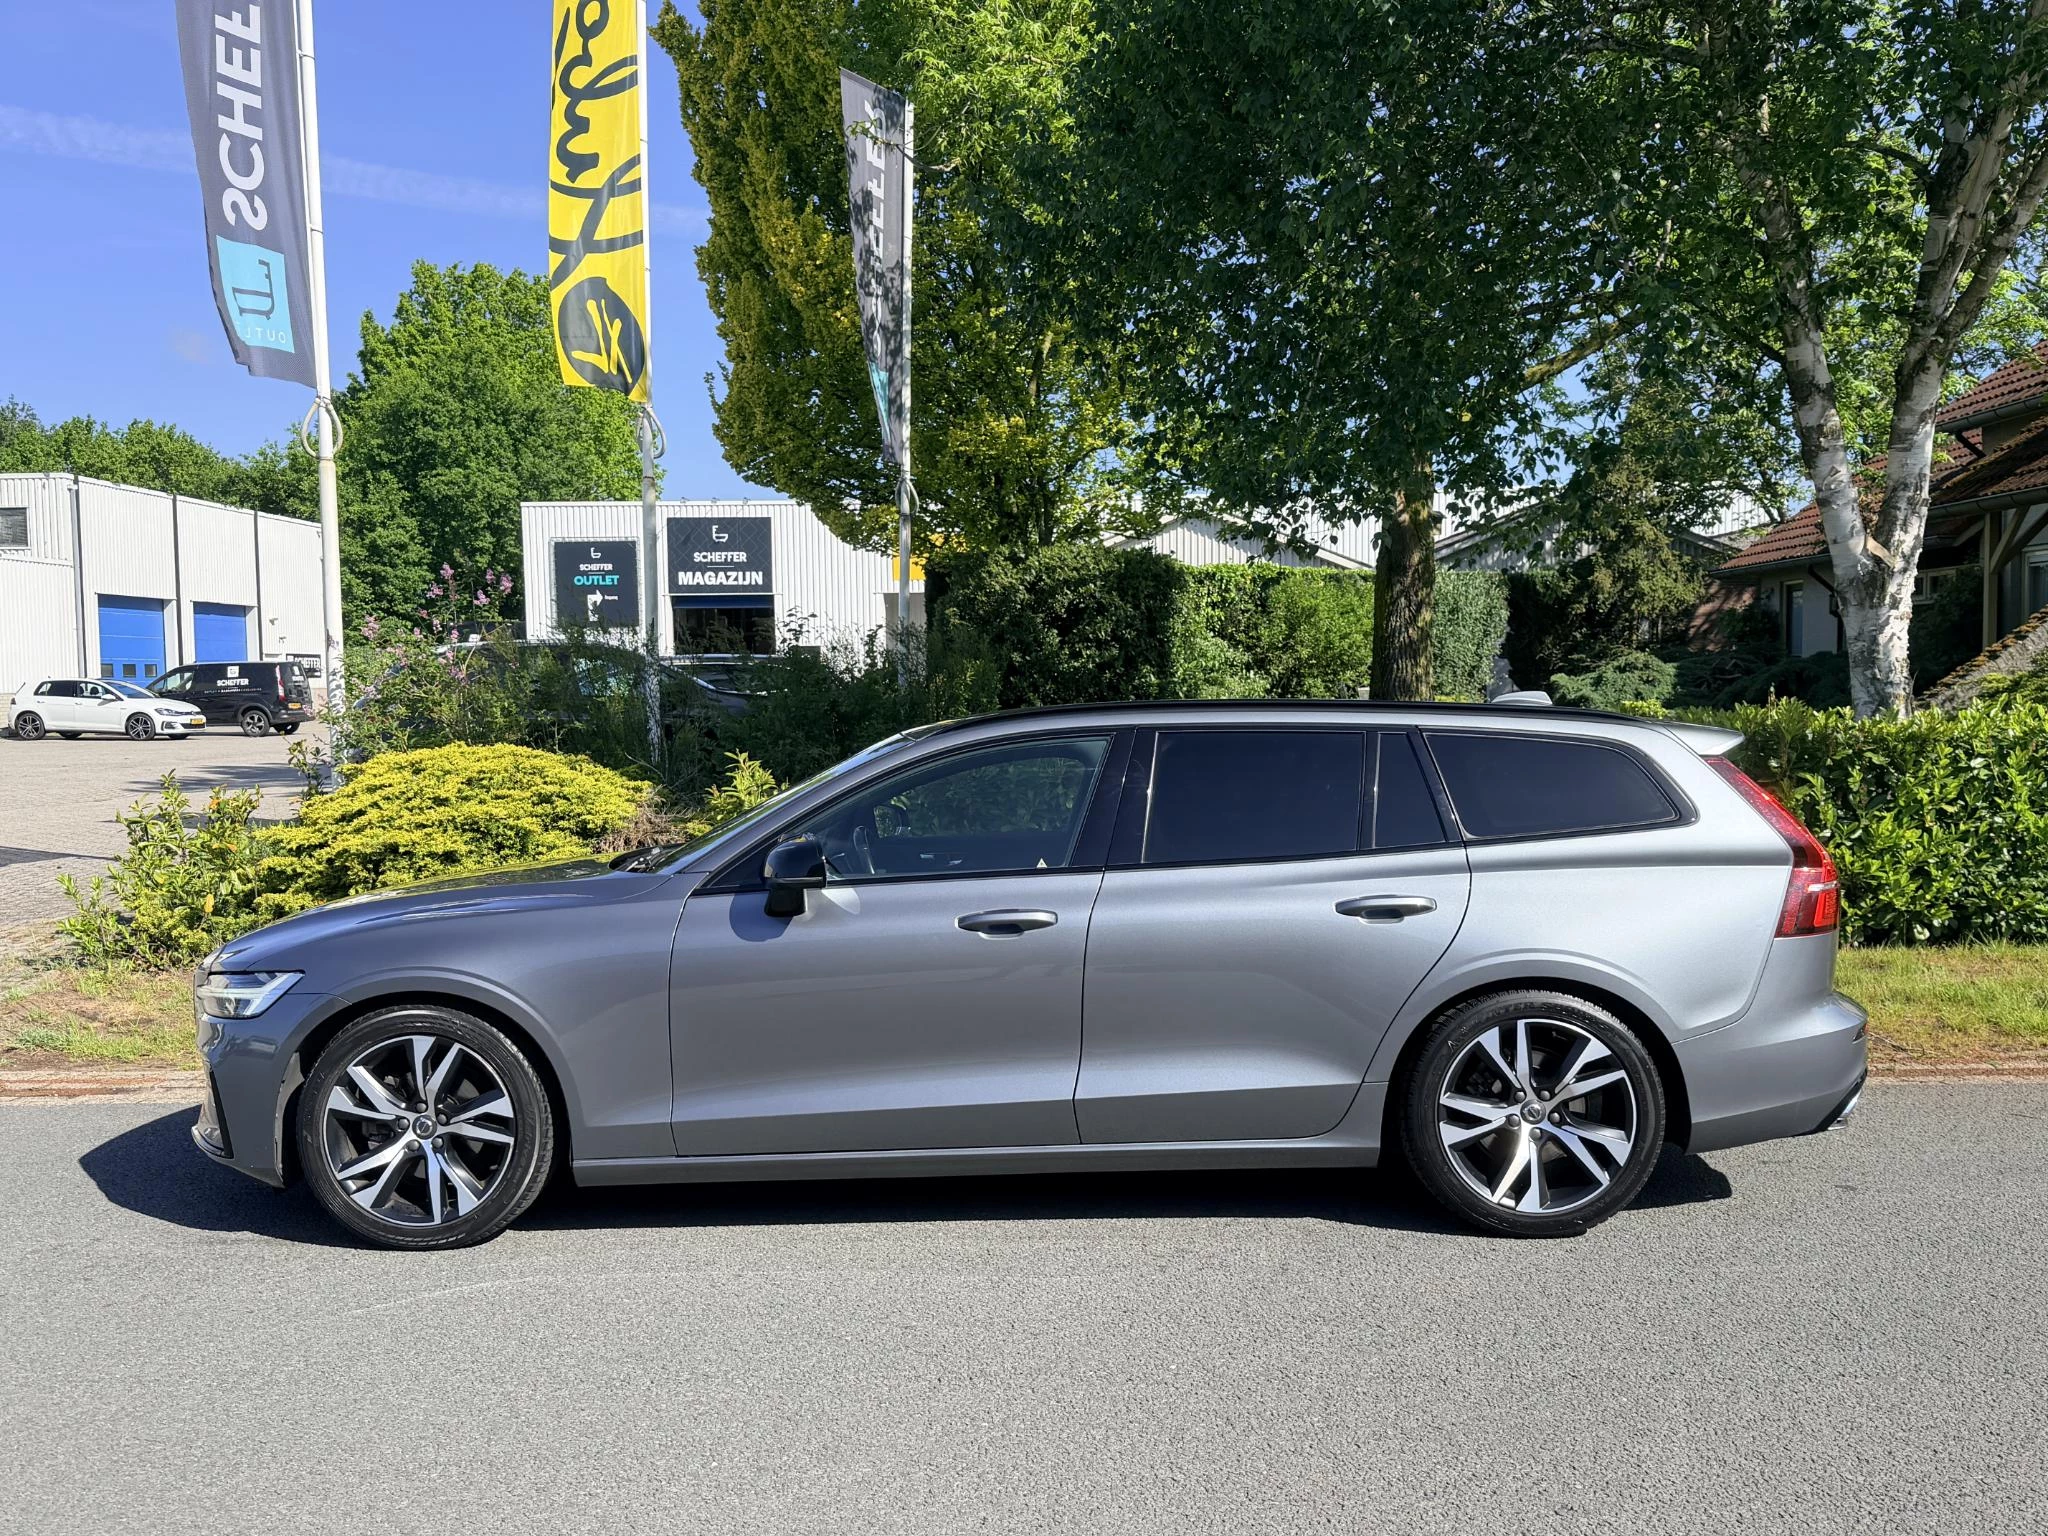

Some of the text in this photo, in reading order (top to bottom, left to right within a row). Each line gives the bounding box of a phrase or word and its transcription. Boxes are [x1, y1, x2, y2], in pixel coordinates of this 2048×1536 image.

[693, 551, 747, 563] SCHEFFER
[579, 563, 613, 571] SCHEFFER
[573, 575, 620, 586] OUTLET
[678, 571, 763, 586] MAGAZIJN
[216, 678, 249, 687] SCHEFFER
